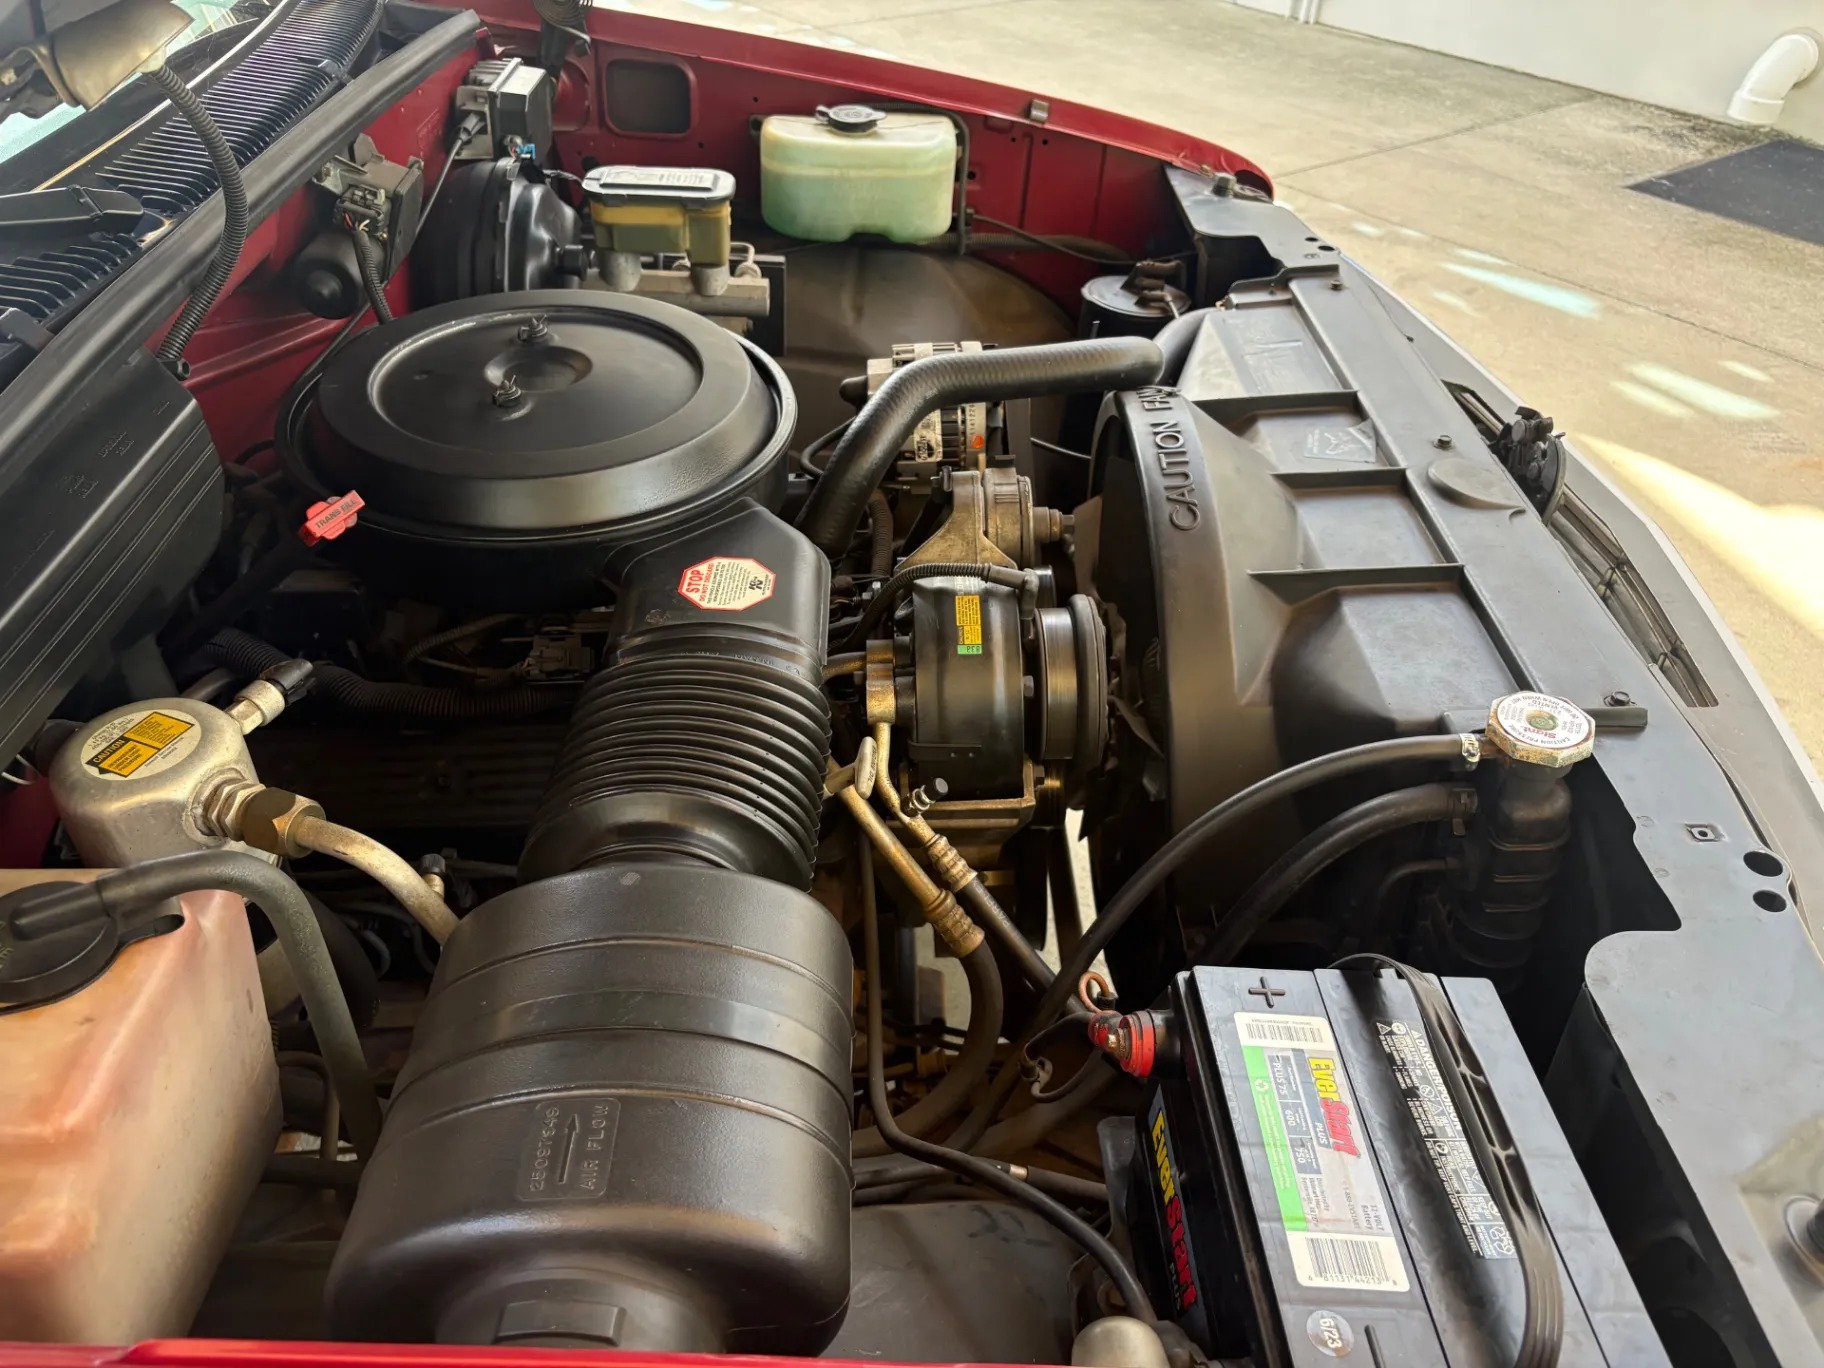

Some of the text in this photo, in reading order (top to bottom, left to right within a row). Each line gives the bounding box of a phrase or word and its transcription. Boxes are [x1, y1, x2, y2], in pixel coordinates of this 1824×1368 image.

[1150, 420, 1200, 531] CAUTION
[315, 508, 342, 528] TRANS
[685, 569, 705, 594] STOP
[92, 739, 125, 763] CAUTION
[1272, 1062, 1288, 1097] PLUS 75
[1284, 1109, 1296, 1127] 600
[1308, 1056, 1360, 1156] EverStart
[1315, 1121, 1329, 1145] PLUS
[579, 1105, 608, 1190] AIR FLOW
[1295, 1147, 1306, 1164] 750
[1152, 1109, 1198, 1311] EverStart
[1360, 1204, 1374, 1231] Battery
[1318, 1315, 1343, 1350] 6/23
